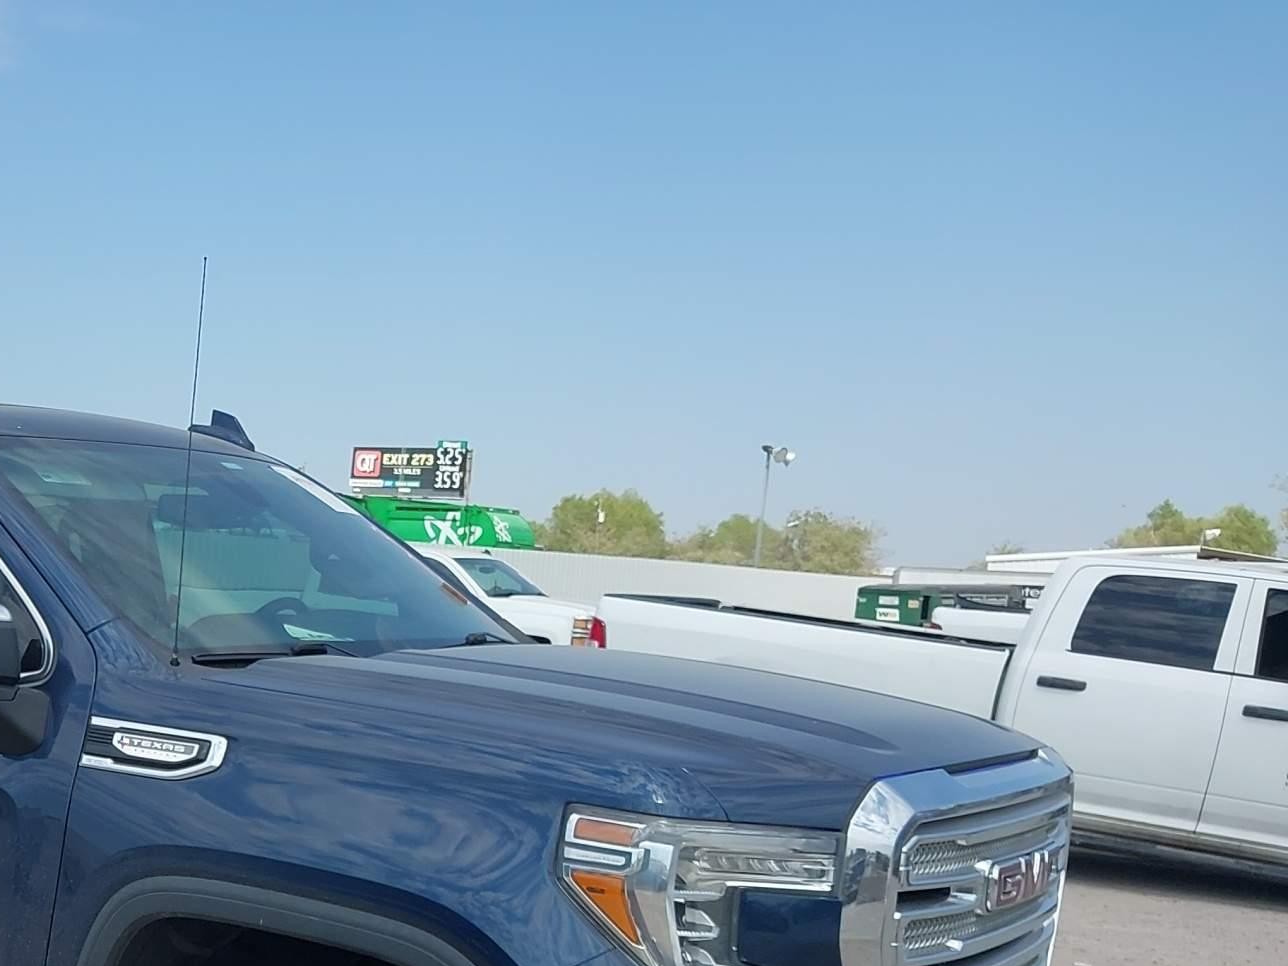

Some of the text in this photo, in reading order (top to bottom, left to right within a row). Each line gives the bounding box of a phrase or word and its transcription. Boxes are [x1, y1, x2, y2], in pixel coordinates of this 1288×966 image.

[357, 454, 376, 472] QT
[383, 453, 434, 465] EXIT 273
[132, 739, 185, 753] TEXAS
[996, 850, 1053, 907] GM
